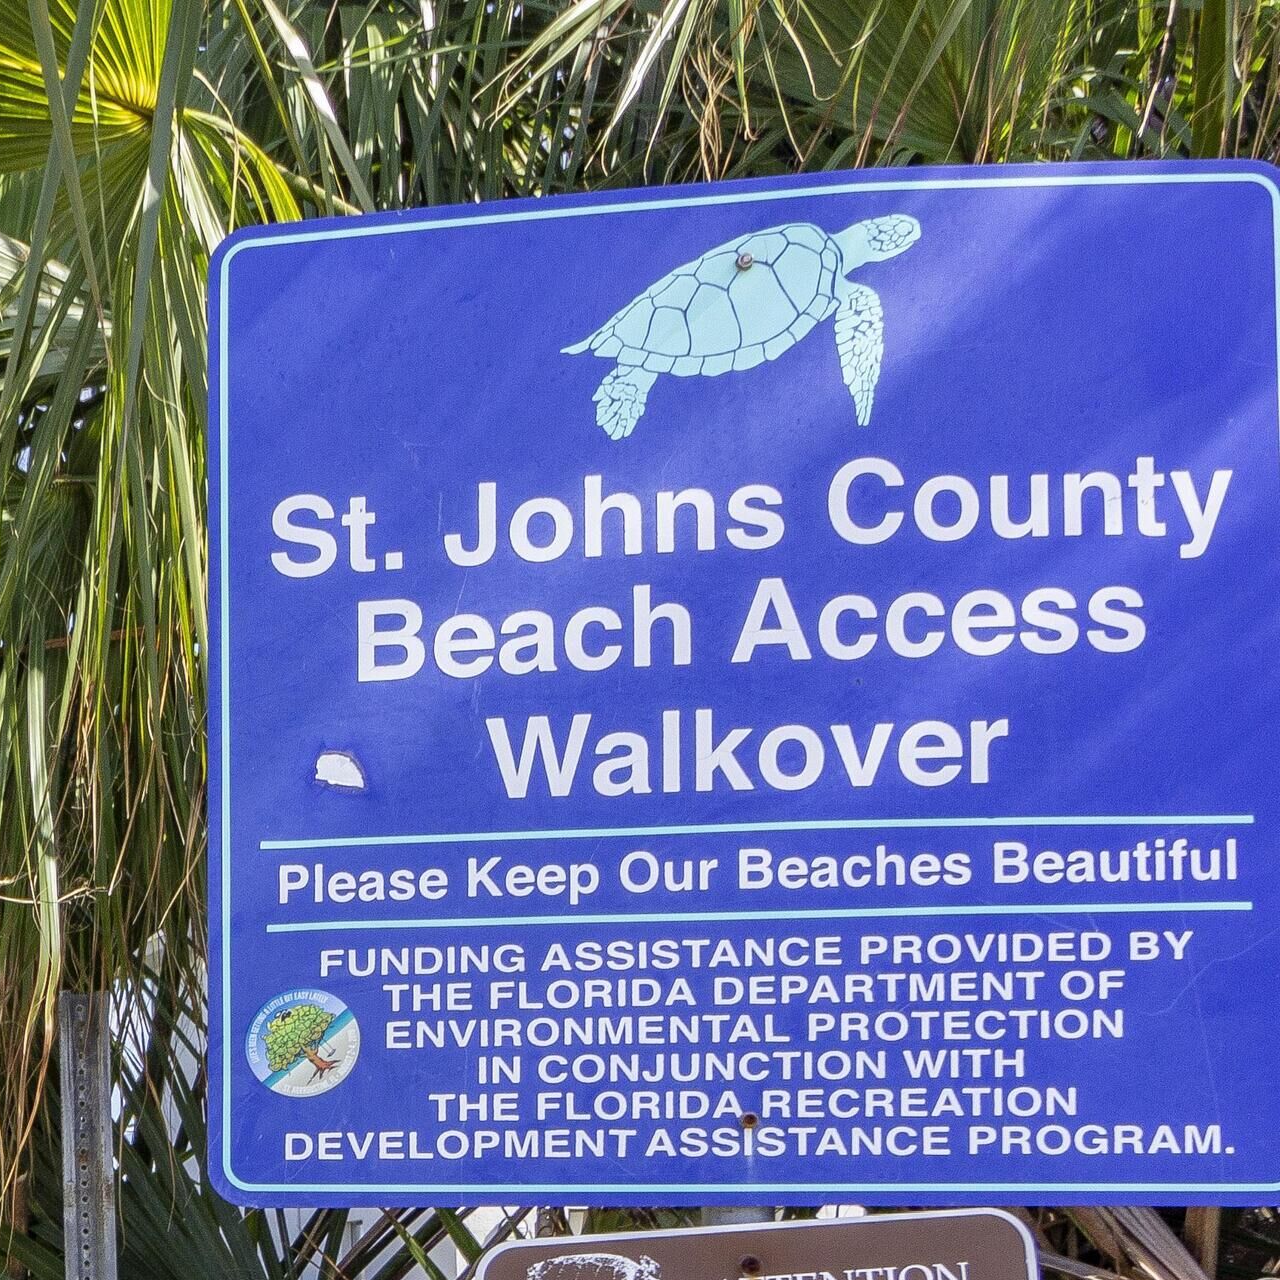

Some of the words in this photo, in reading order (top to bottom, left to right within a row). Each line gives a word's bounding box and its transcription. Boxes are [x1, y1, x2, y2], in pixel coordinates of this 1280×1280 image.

[270, 493, 404, 578] St.
[442, 473, 785, 566] Johns
[826, 455, 1233, 559] County
[356, 583, 692, 682] Beach
[731, 576, 1147, 663] Access
[484, 707, 1009, 798] Walkover
[277, 862, 449, 904] Please
[466, 856, 600, 905] Keep
[618, 850, 719, 893] Our
[737, 844, 972, 889] Beaches
[992, 837, 1238, 883] Beautiful
[319, 943, 526, 977] FUNDING
[539, 935, 843, 971] ASSISTANCE
[859, 930, 1112, 964] PROVIDED
[1128, 930, 1193, 960] BY
[381, 981, 473, 1012] THE
[488, 977, 697, 1010] FLORIDA
[712, 970, 1046, 1005] DEPARTMENT
[1058, 969, 1126, 1000] OF
[384, 1013, 791, 1049] ENVIRONMENTAL
[806, 1008, 1124, 1041] PROTECTION
[477, 1055, 522, 1084] IN
[536, 1049, 887, 1084] CONJUNCTION
[901, 1047, 1025, 1078] WITH
[427, 1092, 520, 1122] THE
[535, 1089, 744, 1120] FLORIDA
[760, 1086, 1078, 1118] RECREATION
[283, 1128, 638, 1160] DEVELOPMENT
[644, 1125, 952, 1160] ASSISTANCE
[967, 1123, 1235, 1155] PROGRAM.
